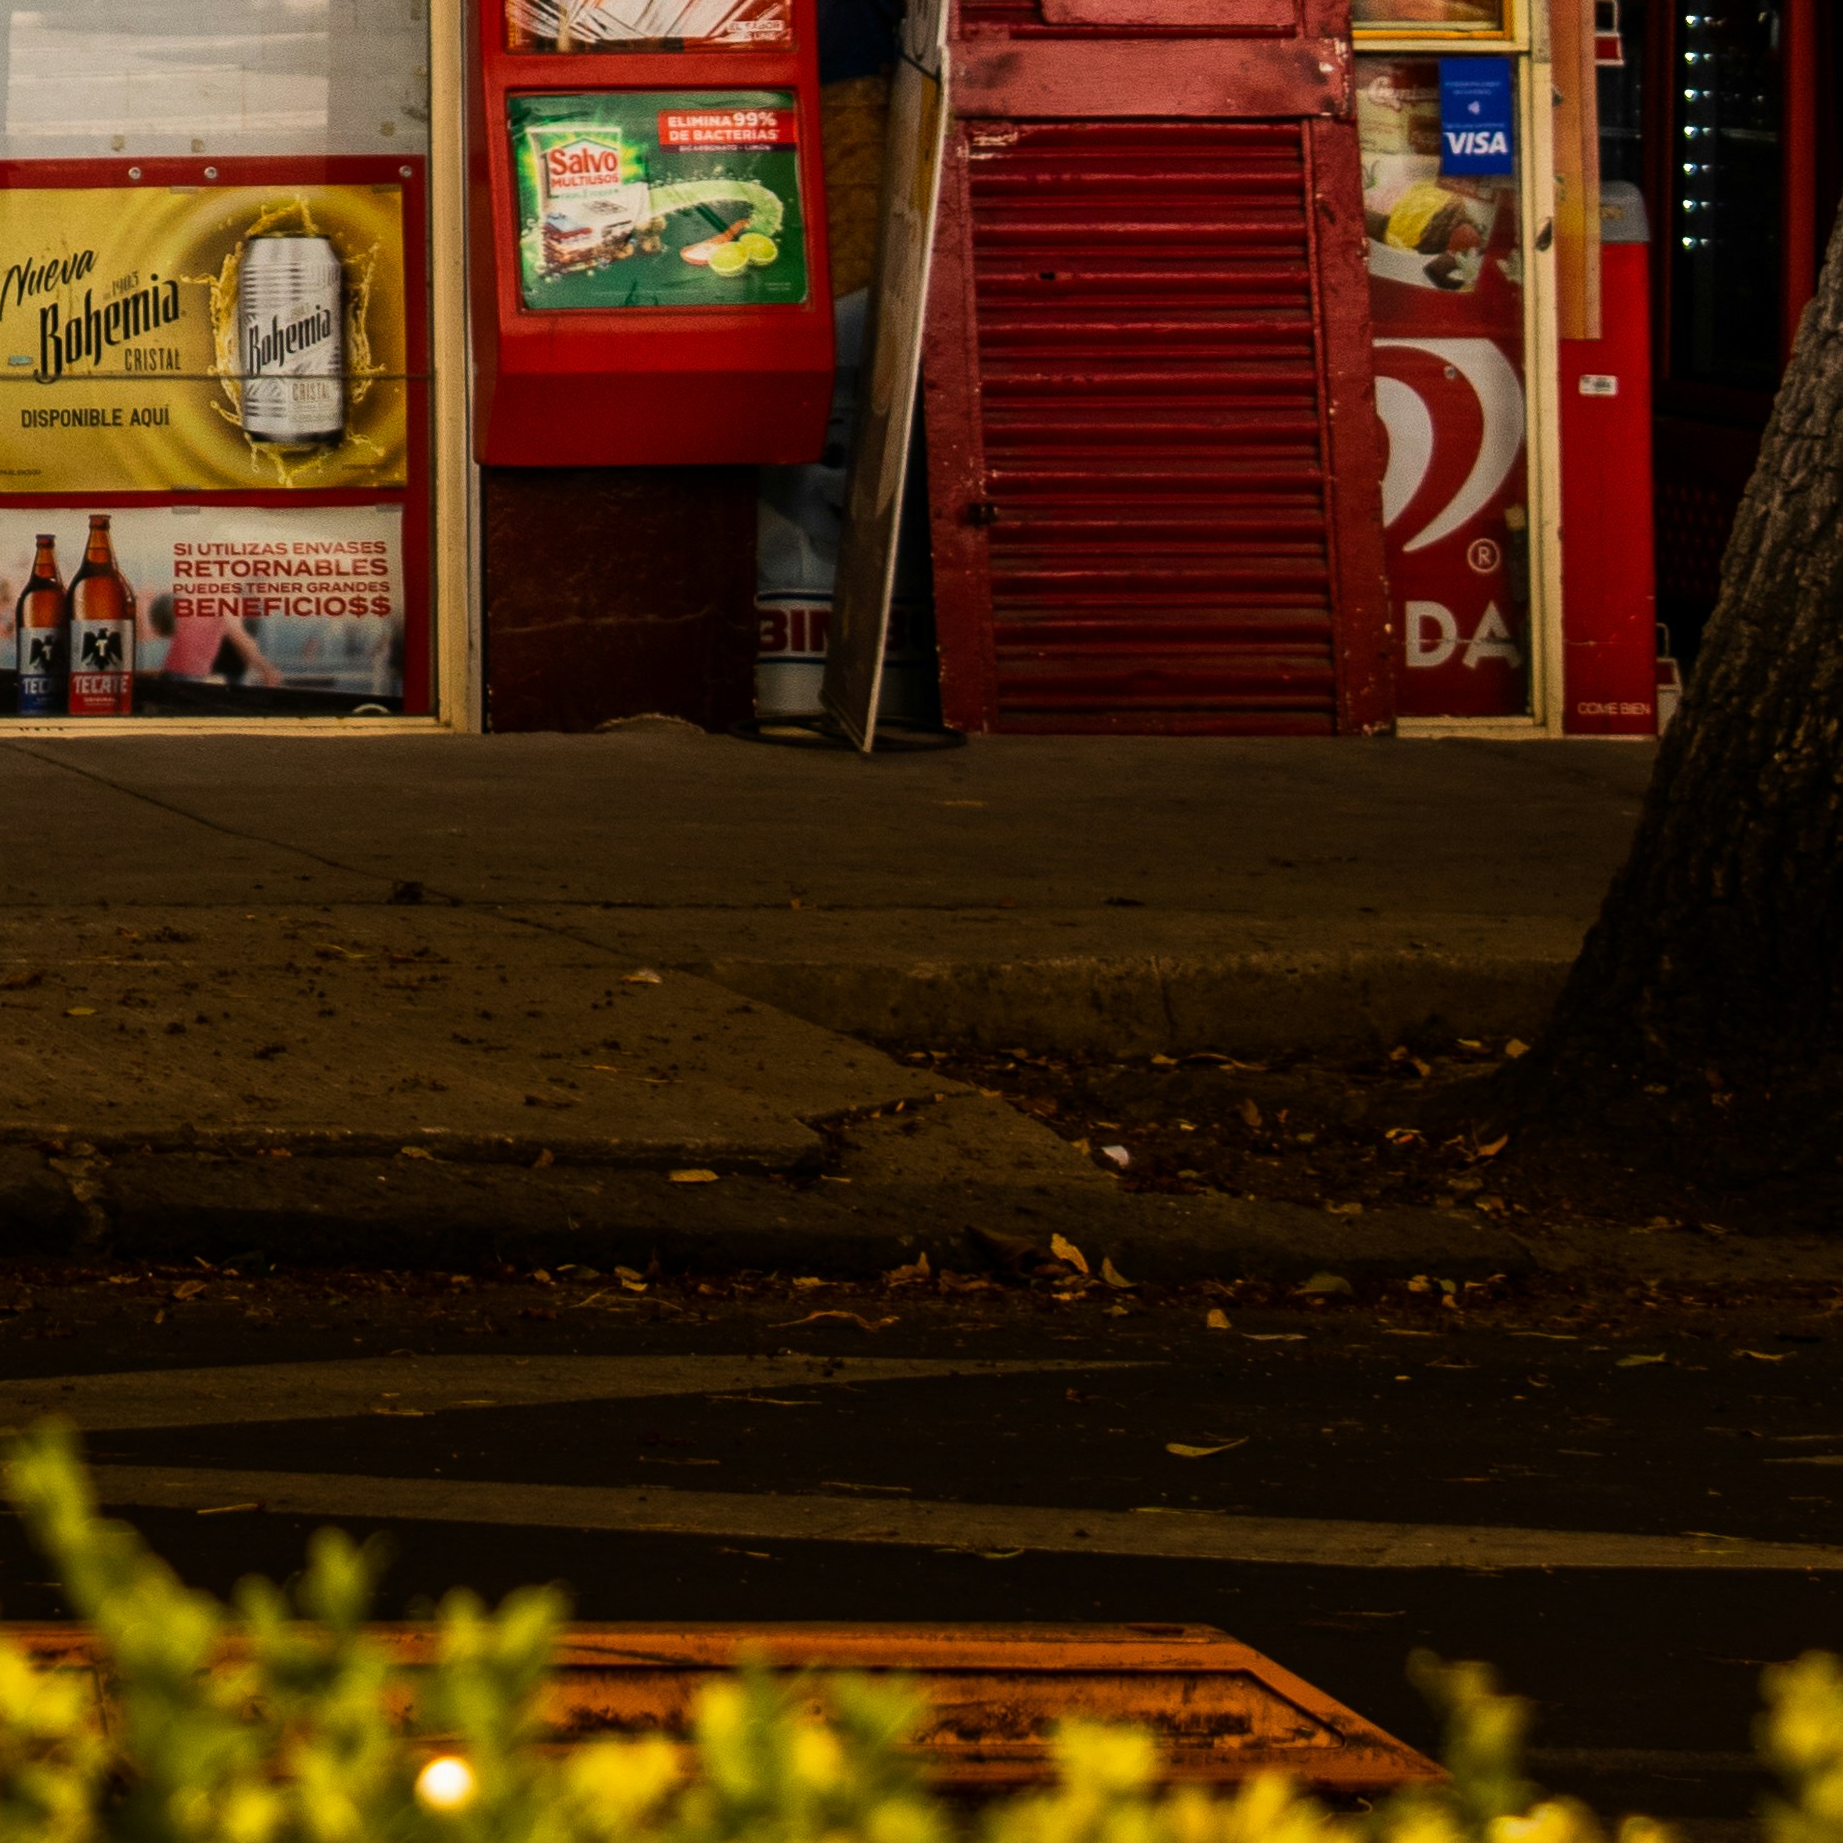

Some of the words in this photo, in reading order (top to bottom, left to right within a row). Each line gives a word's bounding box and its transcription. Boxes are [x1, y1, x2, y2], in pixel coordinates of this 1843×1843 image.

[668, 115, 731, 128] ELIMINA
[669, 129, 690, 142] DE
[1442, 131, 1509, 155] VISA
[548, 147, 618, 176] Salvo
[0, 249, 100, 322] Nueva
[34, 272, 183, 384] Bohemia
[247, 304, 332, 378] Bohemia
[124, 347, 182, 372] CRISTAL
[21, 408, 122, 429] DISPONIBLE
[173, 542, 193, 557] SI
[197, 541, 288, 557] UTILIZAS
[292, 540, 388, 555] ENVASES
[173, 557, 389, 578] RETORNABLES
[173, 582, 243, 594] PUEDES
[246, 581, 303, 594] TENER
[306, 581, 391, 593] GRANDES
[73, 674, 131, 695] TECATE
